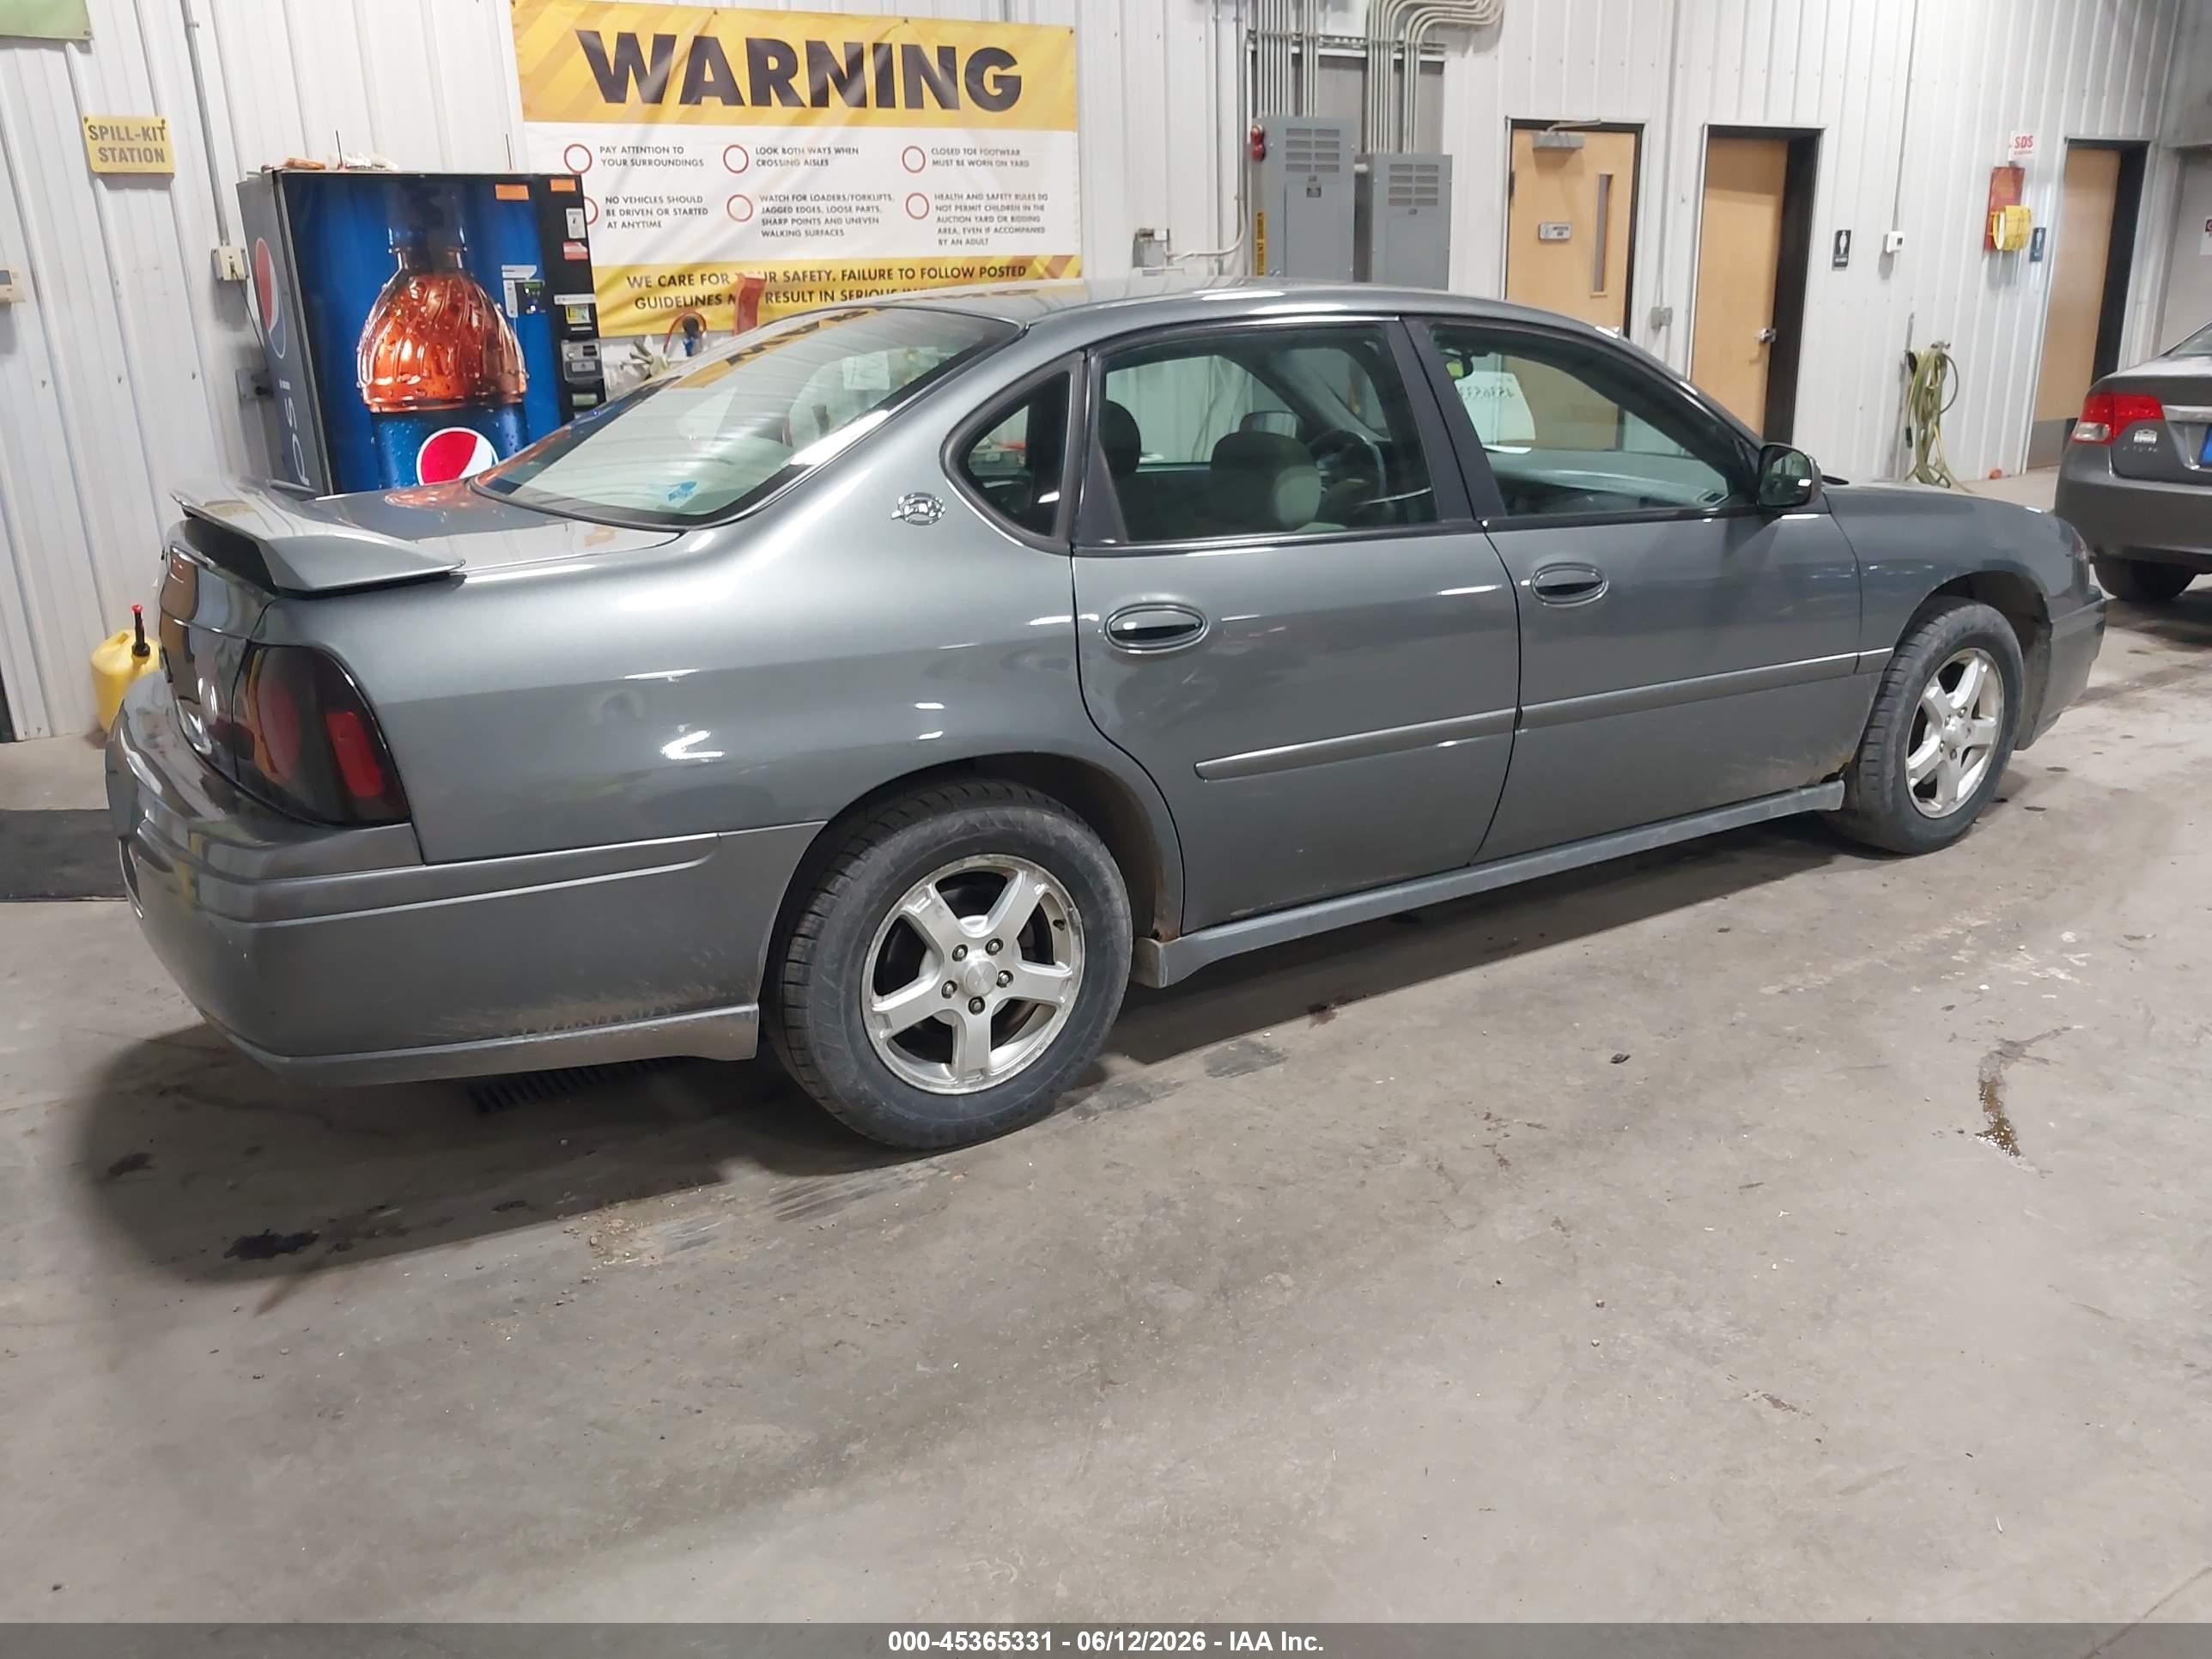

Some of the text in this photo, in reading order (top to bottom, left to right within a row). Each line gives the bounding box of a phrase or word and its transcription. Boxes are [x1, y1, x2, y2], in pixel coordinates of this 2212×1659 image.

[576, 30, 1022, 112] WARNING
[88, 125, 165, 142] SPILL-KIT
[2014, 136, 2033, 149] SDS
[98, 147, 165, 162] STATION
[628, 276, 652, 289] WE
[658, 272, 694, 287] CARE
[701, 272, 730, 286] FOR
[784, 270, 836, 283] SAFETY.
[842, 269, 893, 282] FAILURE
[899, 268, 915, 279] TO
[921, 267, 975, 279] FOLLOW
[980, 265, 1026, 278] POSTED
[635, 294, 722, 309] GUIDELINES
[766, 291, 813, 304] RESULT
[820, 291, 835, 302] IN
